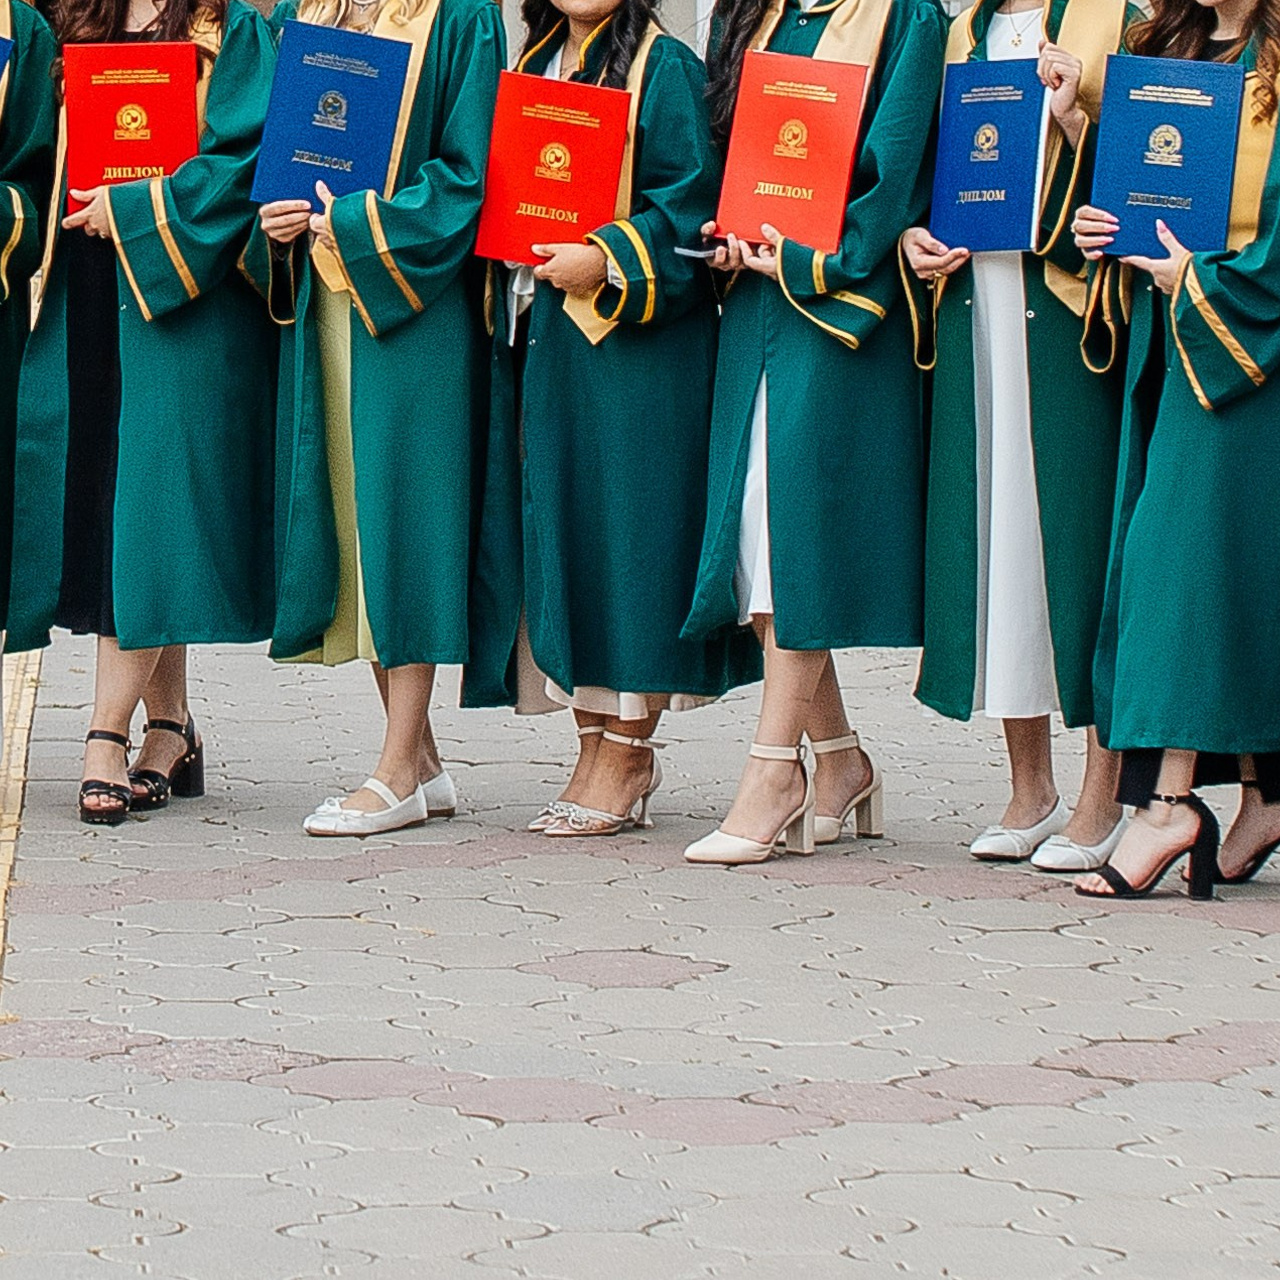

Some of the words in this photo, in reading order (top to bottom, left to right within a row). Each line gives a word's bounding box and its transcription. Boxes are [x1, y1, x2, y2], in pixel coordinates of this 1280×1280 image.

[103, 166, 164, 180] ДИПЛОМ
[754, 181, 814, 200] ДИПЛОМ
[956, 190, 1006, 204] ДИПЛОМ
[516, 202, 579, 223] ДИПЛОМ
